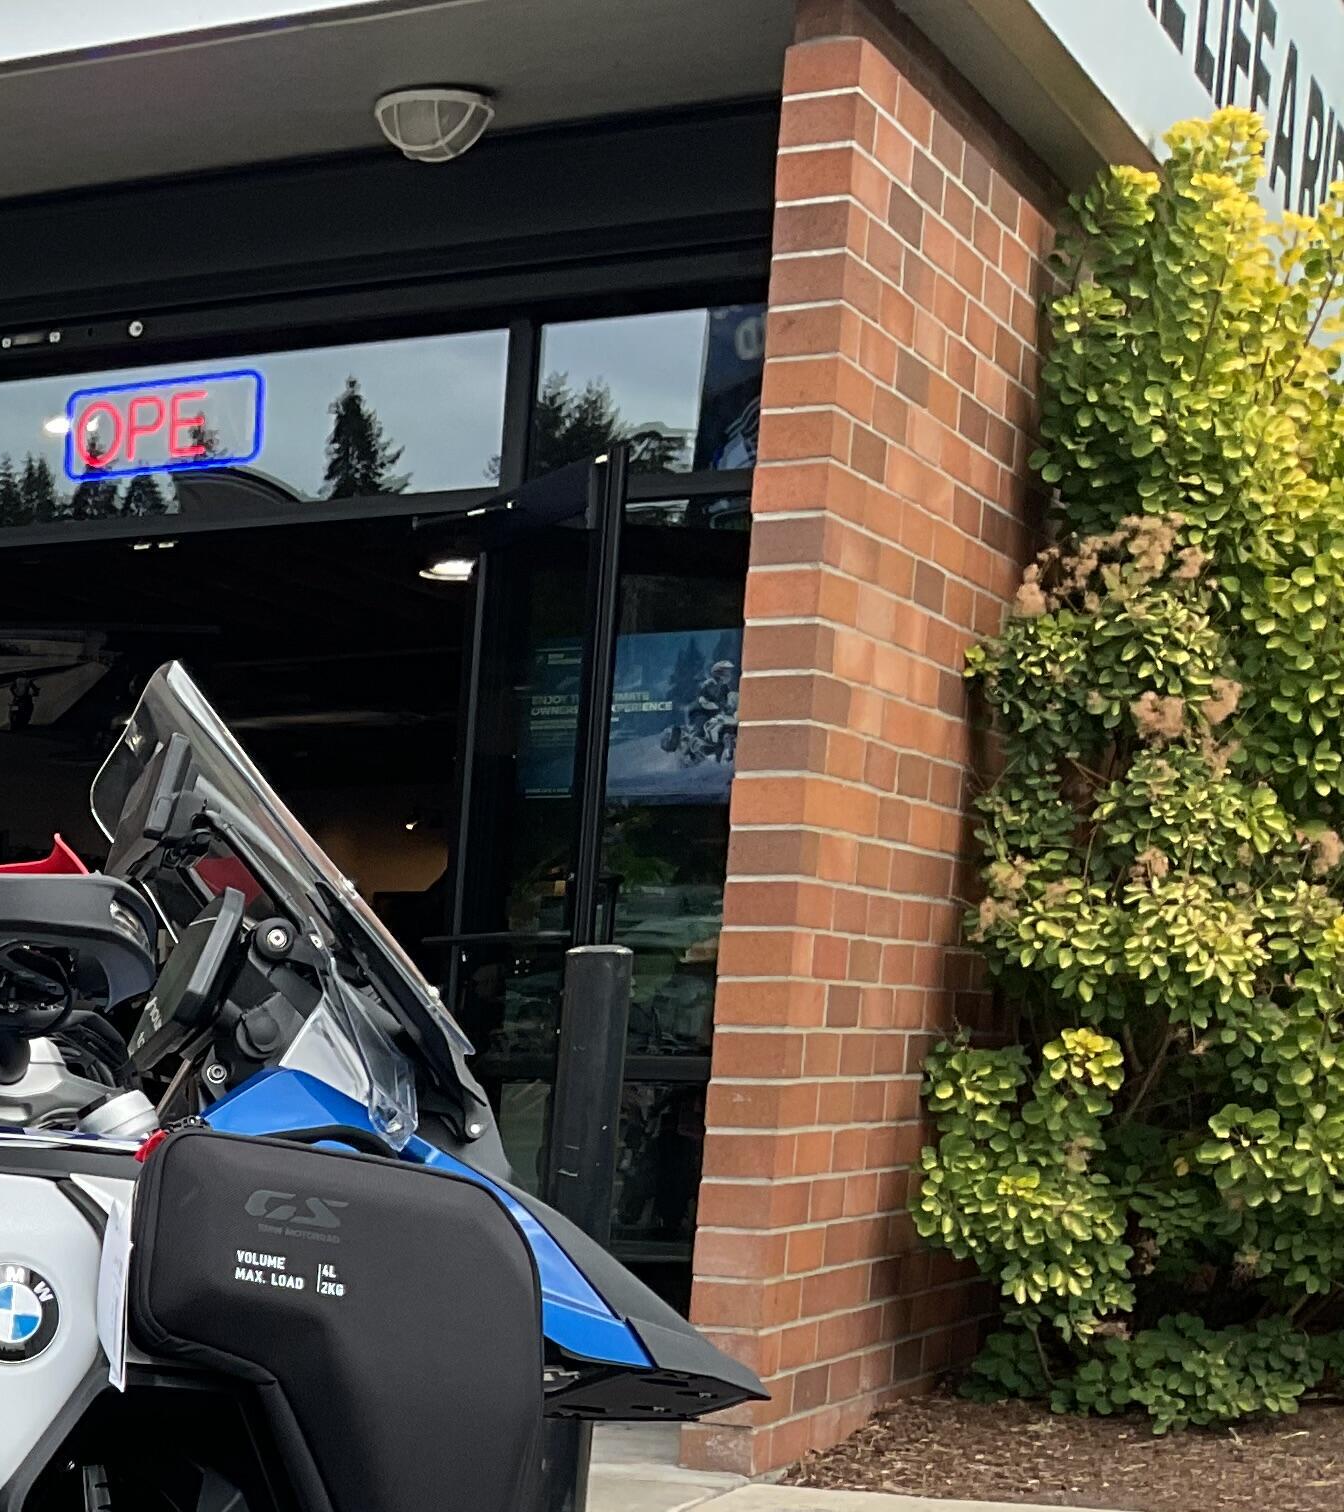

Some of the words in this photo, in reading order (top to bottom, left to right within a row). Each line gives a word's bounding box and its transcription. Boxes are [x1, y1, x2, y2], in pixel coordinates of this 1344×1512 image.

[1269, 39, 1298, 211] A
[1298, 74, 1344, 217] RI
[244, 1189, 350, 1229] GS
[236, 1249, 287, 1270] VOLUME
[234, 1267, 267, 1285] MAX.
[270, 1272, 305, 1291] LOAD
[320, 1281, 345, 1297] 2KG
